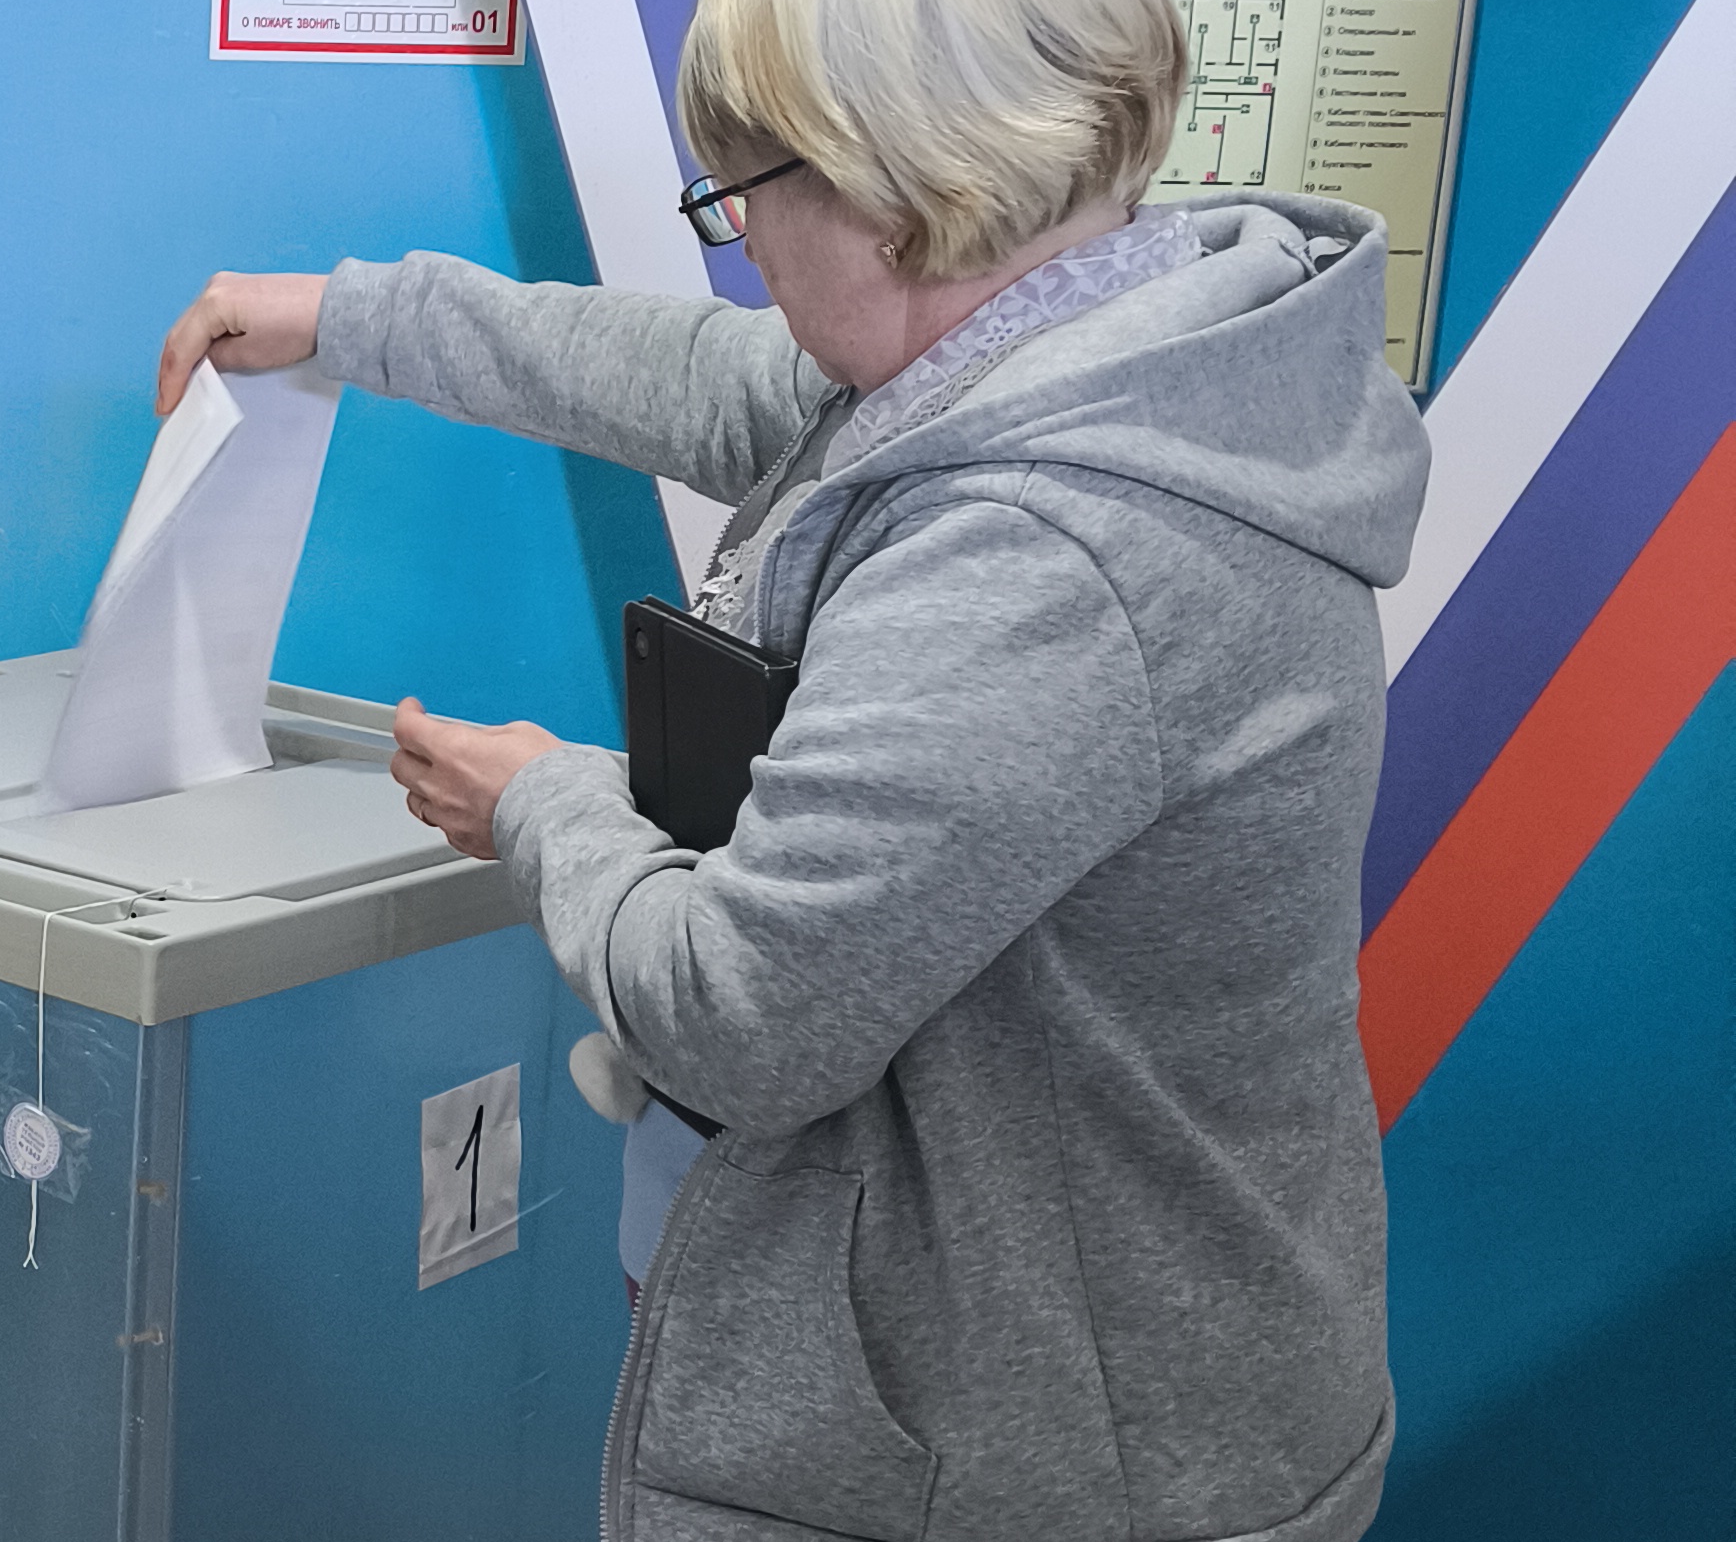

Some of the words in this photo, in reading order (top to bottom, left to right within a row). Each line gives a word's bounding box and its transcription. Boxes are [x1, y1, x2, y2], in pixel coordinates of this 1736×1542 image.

[253, 17, 293, 29] ПОЖАРЕ
[296, 18, 341, 30] ЗВОНИТЬ
[471, 10, 499, 34] 01
[455, 1104, 484, 1232] 1
